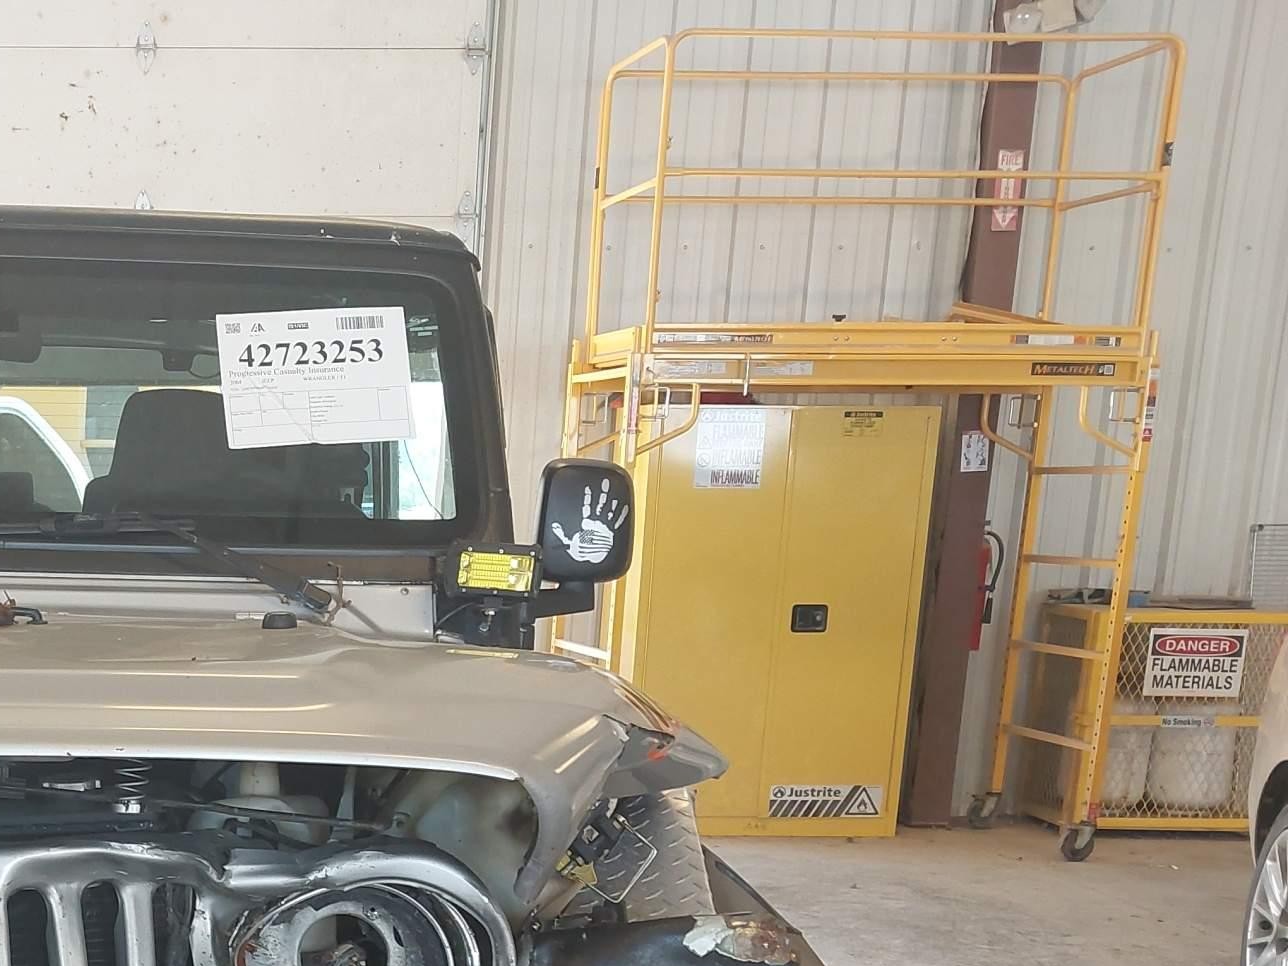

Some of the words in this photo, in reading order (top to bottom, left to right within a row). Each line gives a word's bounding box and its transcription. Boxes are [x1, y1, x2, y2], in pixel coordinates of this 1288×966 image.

[1001, 152, 1022, 166] FIRE
[238, 338, 384, 367] 42723253
[228, 369, 272, 379] Progressive
[273, 366, 306, 377] Casualty
[308, 366, 345, 374] Insurance
[1033, 363, 1095, 375] METALTECH
[711, 469, 761, 485] INFLAMMABLE
[1165, 640, 1230, 652] DANGER
[1151, 658, 1238, 673] FLAMMABLE
[1152, 675, 1233, 690] MATERIALS
[1162, 718, 1171, 726] No
[1172, 718, 1202, 727] Smoking
[787, 787, 841, 798] Justrite
